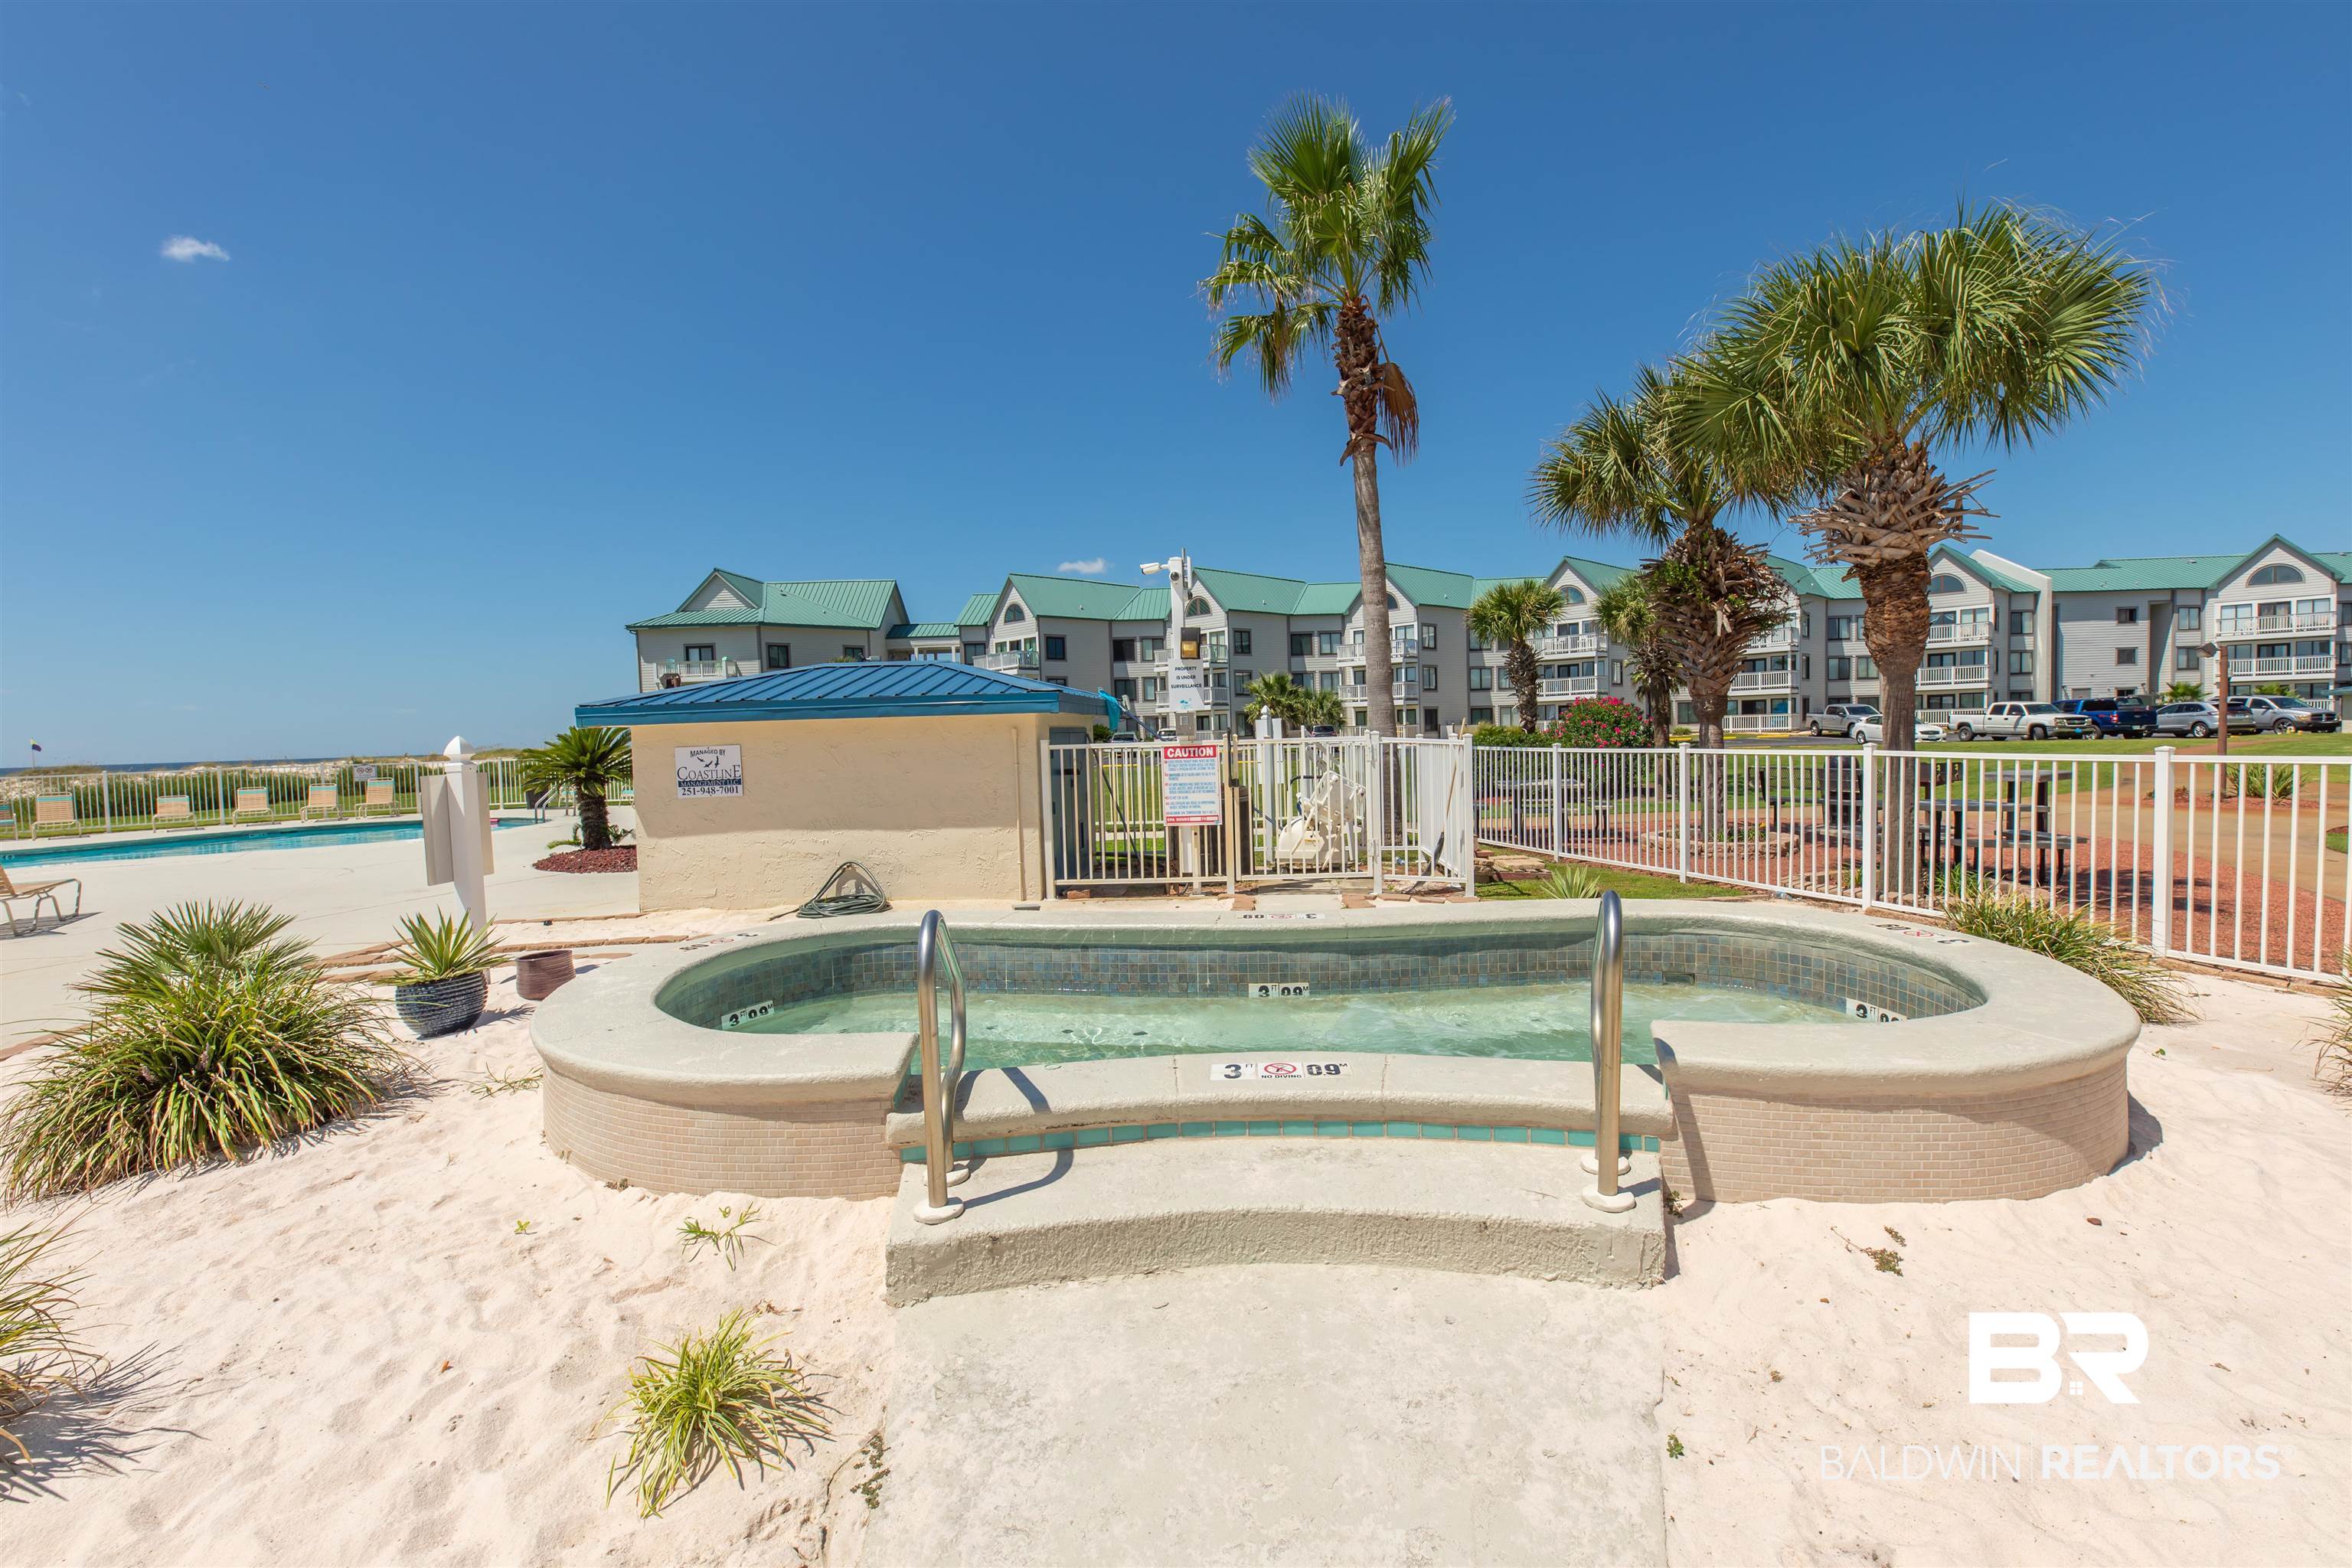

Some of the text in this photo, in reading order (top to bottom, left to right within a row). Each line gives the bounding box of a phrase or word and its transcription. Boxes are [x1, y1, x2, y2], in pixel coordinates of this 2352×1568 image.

[690, 750, 718, 758] MANAGED
[1167, 747, 1214, 758] CAUTION
[677, 764, 742, 780] COASTLINE
[681, 786, 739, 796] 251-948-7001
[1259, 985, 1270, 997] 3
[1856, 1004, 1868, 1018] 3
[729, 1014, 740, 1026] 3
[1224, 1064, 1242, 1079] 3
